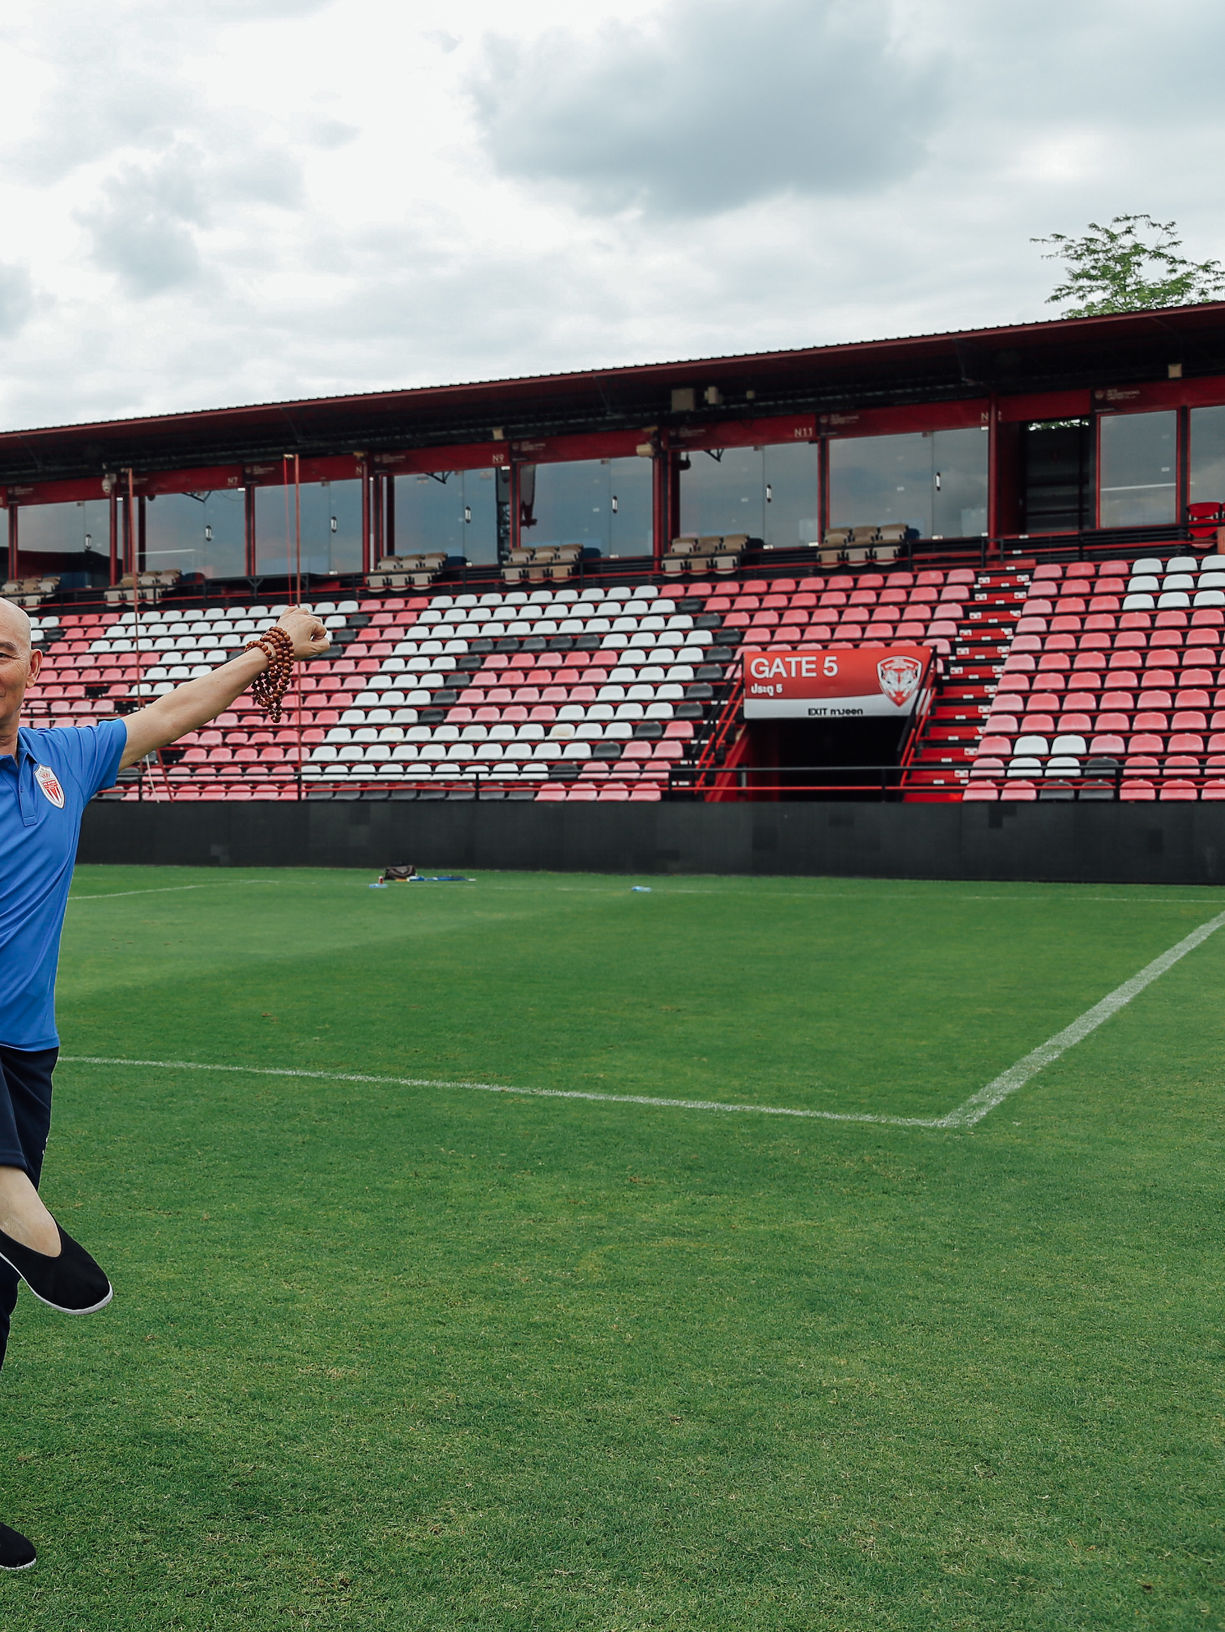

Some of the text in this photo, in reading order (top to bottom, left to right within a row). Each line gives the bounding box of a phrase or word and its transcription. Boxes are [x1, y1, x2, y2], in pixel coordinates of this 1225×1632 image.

[794, 427, 813, 438] N11
[750, 656, 838, 678] GATE 5
[808, 708, 827, 716] EXIT
